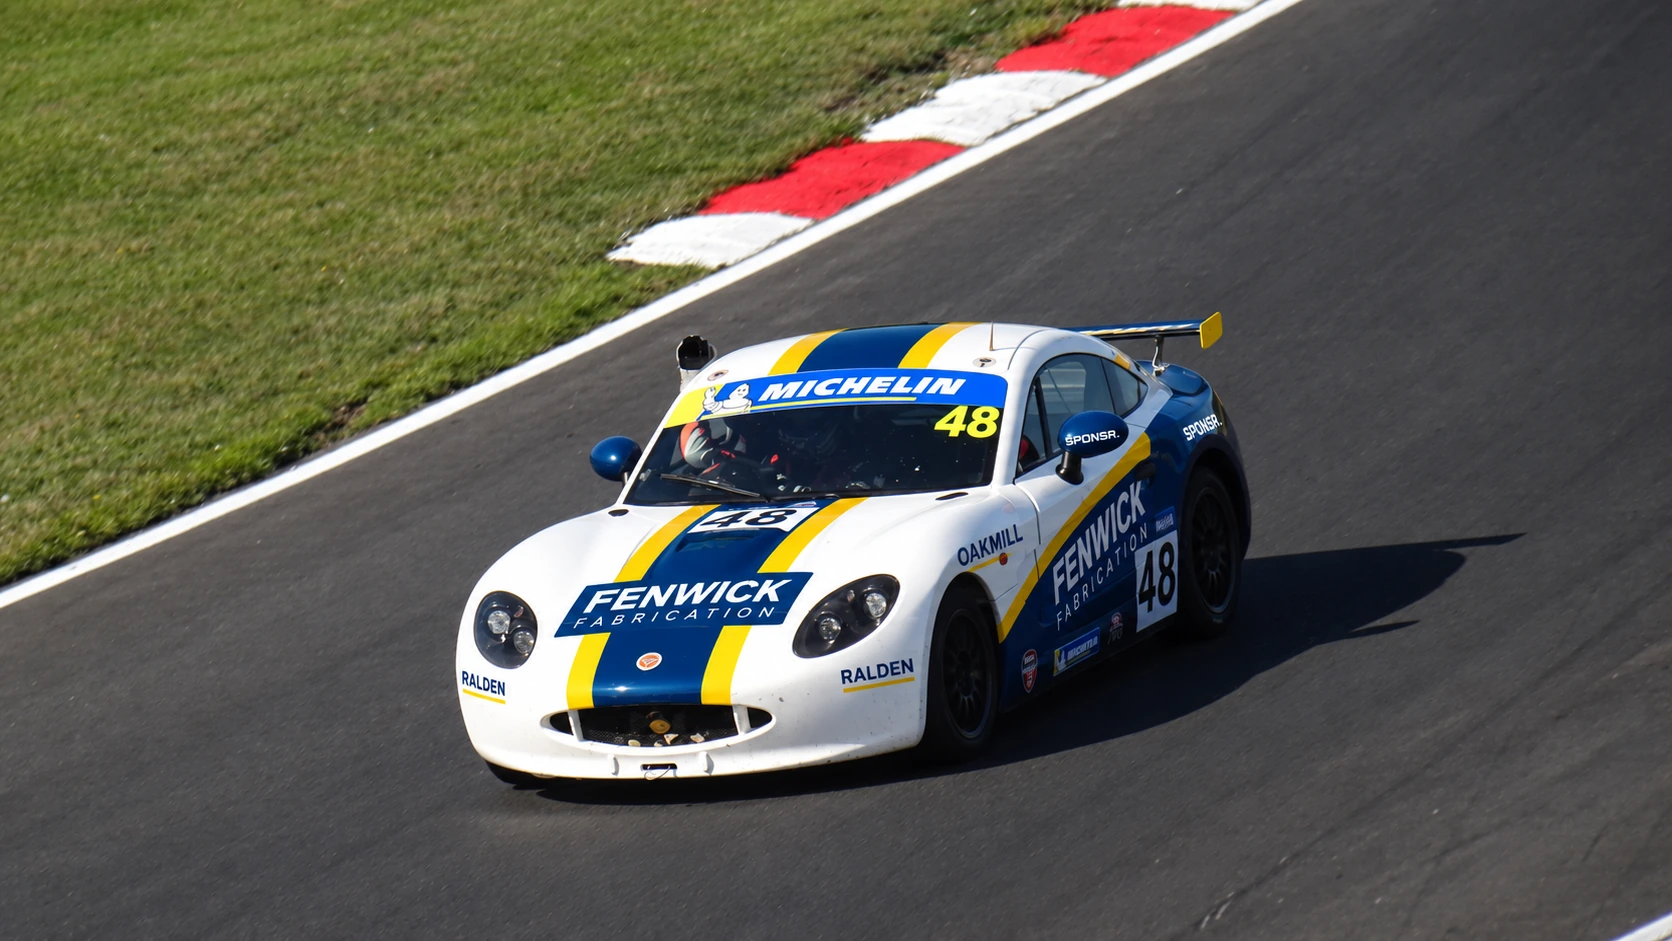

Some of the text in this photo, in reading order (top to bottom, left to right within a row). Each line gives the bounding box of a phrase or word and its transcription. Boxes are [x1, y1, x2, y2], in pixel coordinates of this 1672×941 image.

[757, 376, 966, 402] MICHELIN
[934, 405, 1000, 438] 48
[1065, 430, 1120, 446] SPONSR.
[700, 508, 798, 528] 48
[957, 524, 1024, 567] OAKMILL
[1053, 480, 1146, 606] FENWICK
[1056, 523, 1148, 631] FABRICATION
[1138, 541, 1176, 614] 48
[583, 579, 792, 615] FENWICK
[573, 607, 775, 630] FABRICATION
[462, 670, 506, 696] RALDEN
[840, 658, 915, 684] RALDEN
